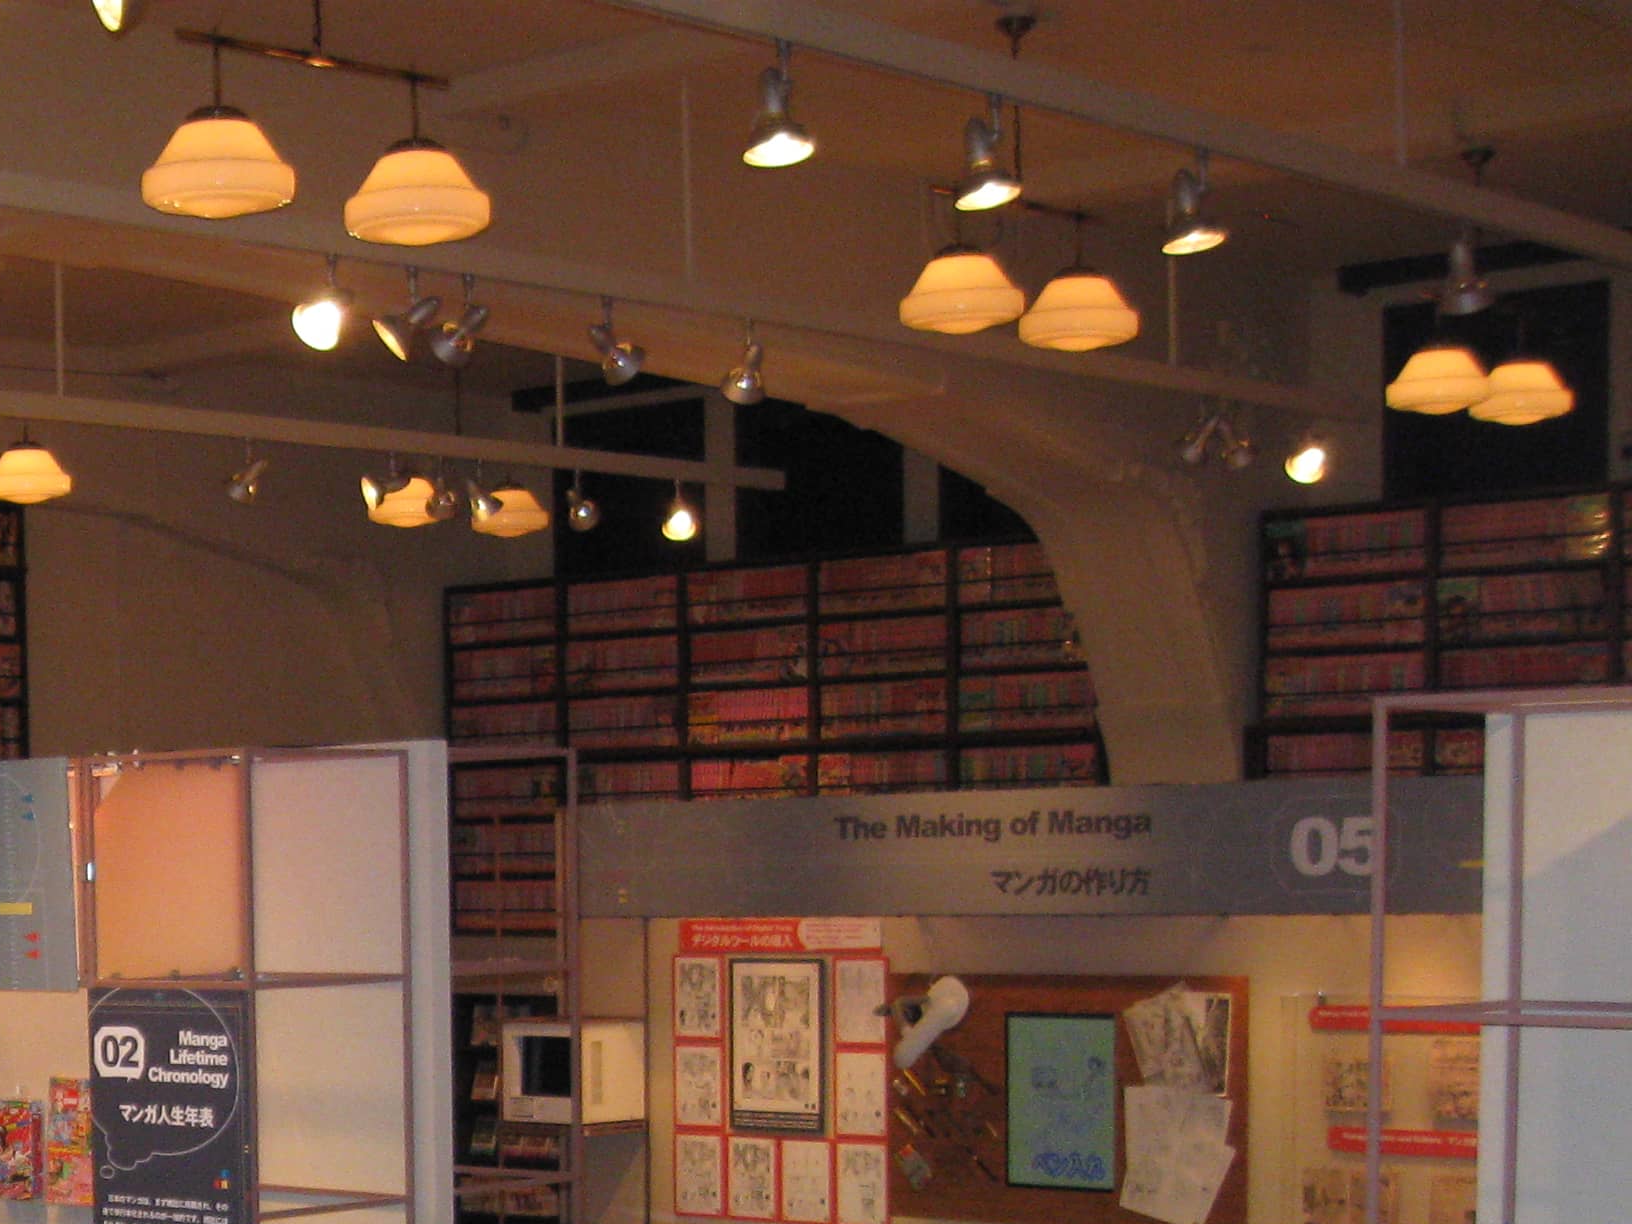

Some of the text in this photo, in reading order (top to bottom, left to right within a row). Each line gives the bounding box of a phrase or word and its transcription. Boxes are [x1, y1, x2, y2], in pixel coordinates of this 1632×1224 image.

[835, 808, 1153, 845] The Making of Manga
[1289, 815, 1377, 878] 05
[990, 866, 1152, 898] マンガの作り方
[101, 1035, 139, 1068] 02
[178, 1031, 228, 1051] Manga
[169, 1049, 228, 1067] Lifetime
[147, 1066, 229, 1089] Chronology
[119, 1102, 215, 1129] マンガ人生年表
